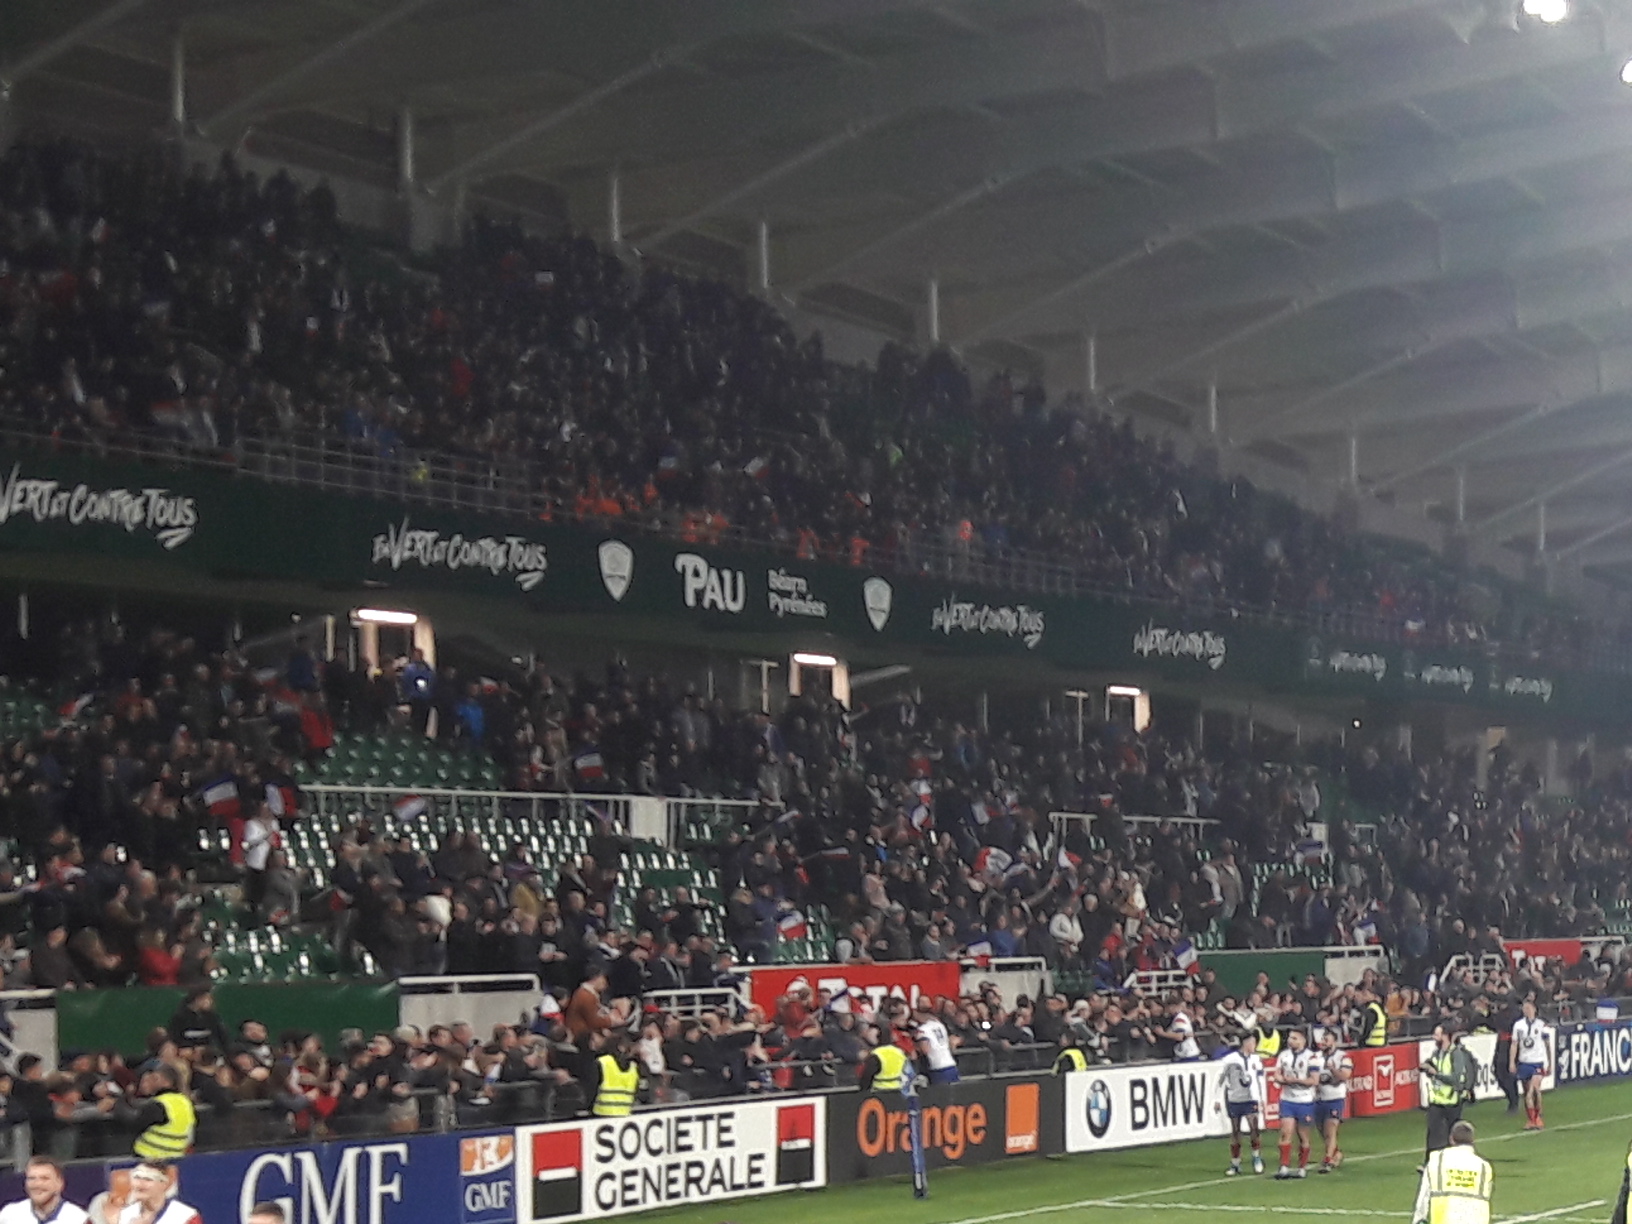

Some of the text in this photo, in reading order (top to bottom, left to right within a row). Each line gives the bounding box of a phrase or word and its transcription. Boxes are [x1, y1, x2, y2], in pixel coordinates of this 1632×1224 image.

[673, 552, 746, 613] PAU
[1129, 1072, 1206, 1131] BMW
[594, 1111, 736, 1164] SOCIETE
[464, 1179, 512, 1213] GMF
[594, 1152, 766, 1211] GENERALE
